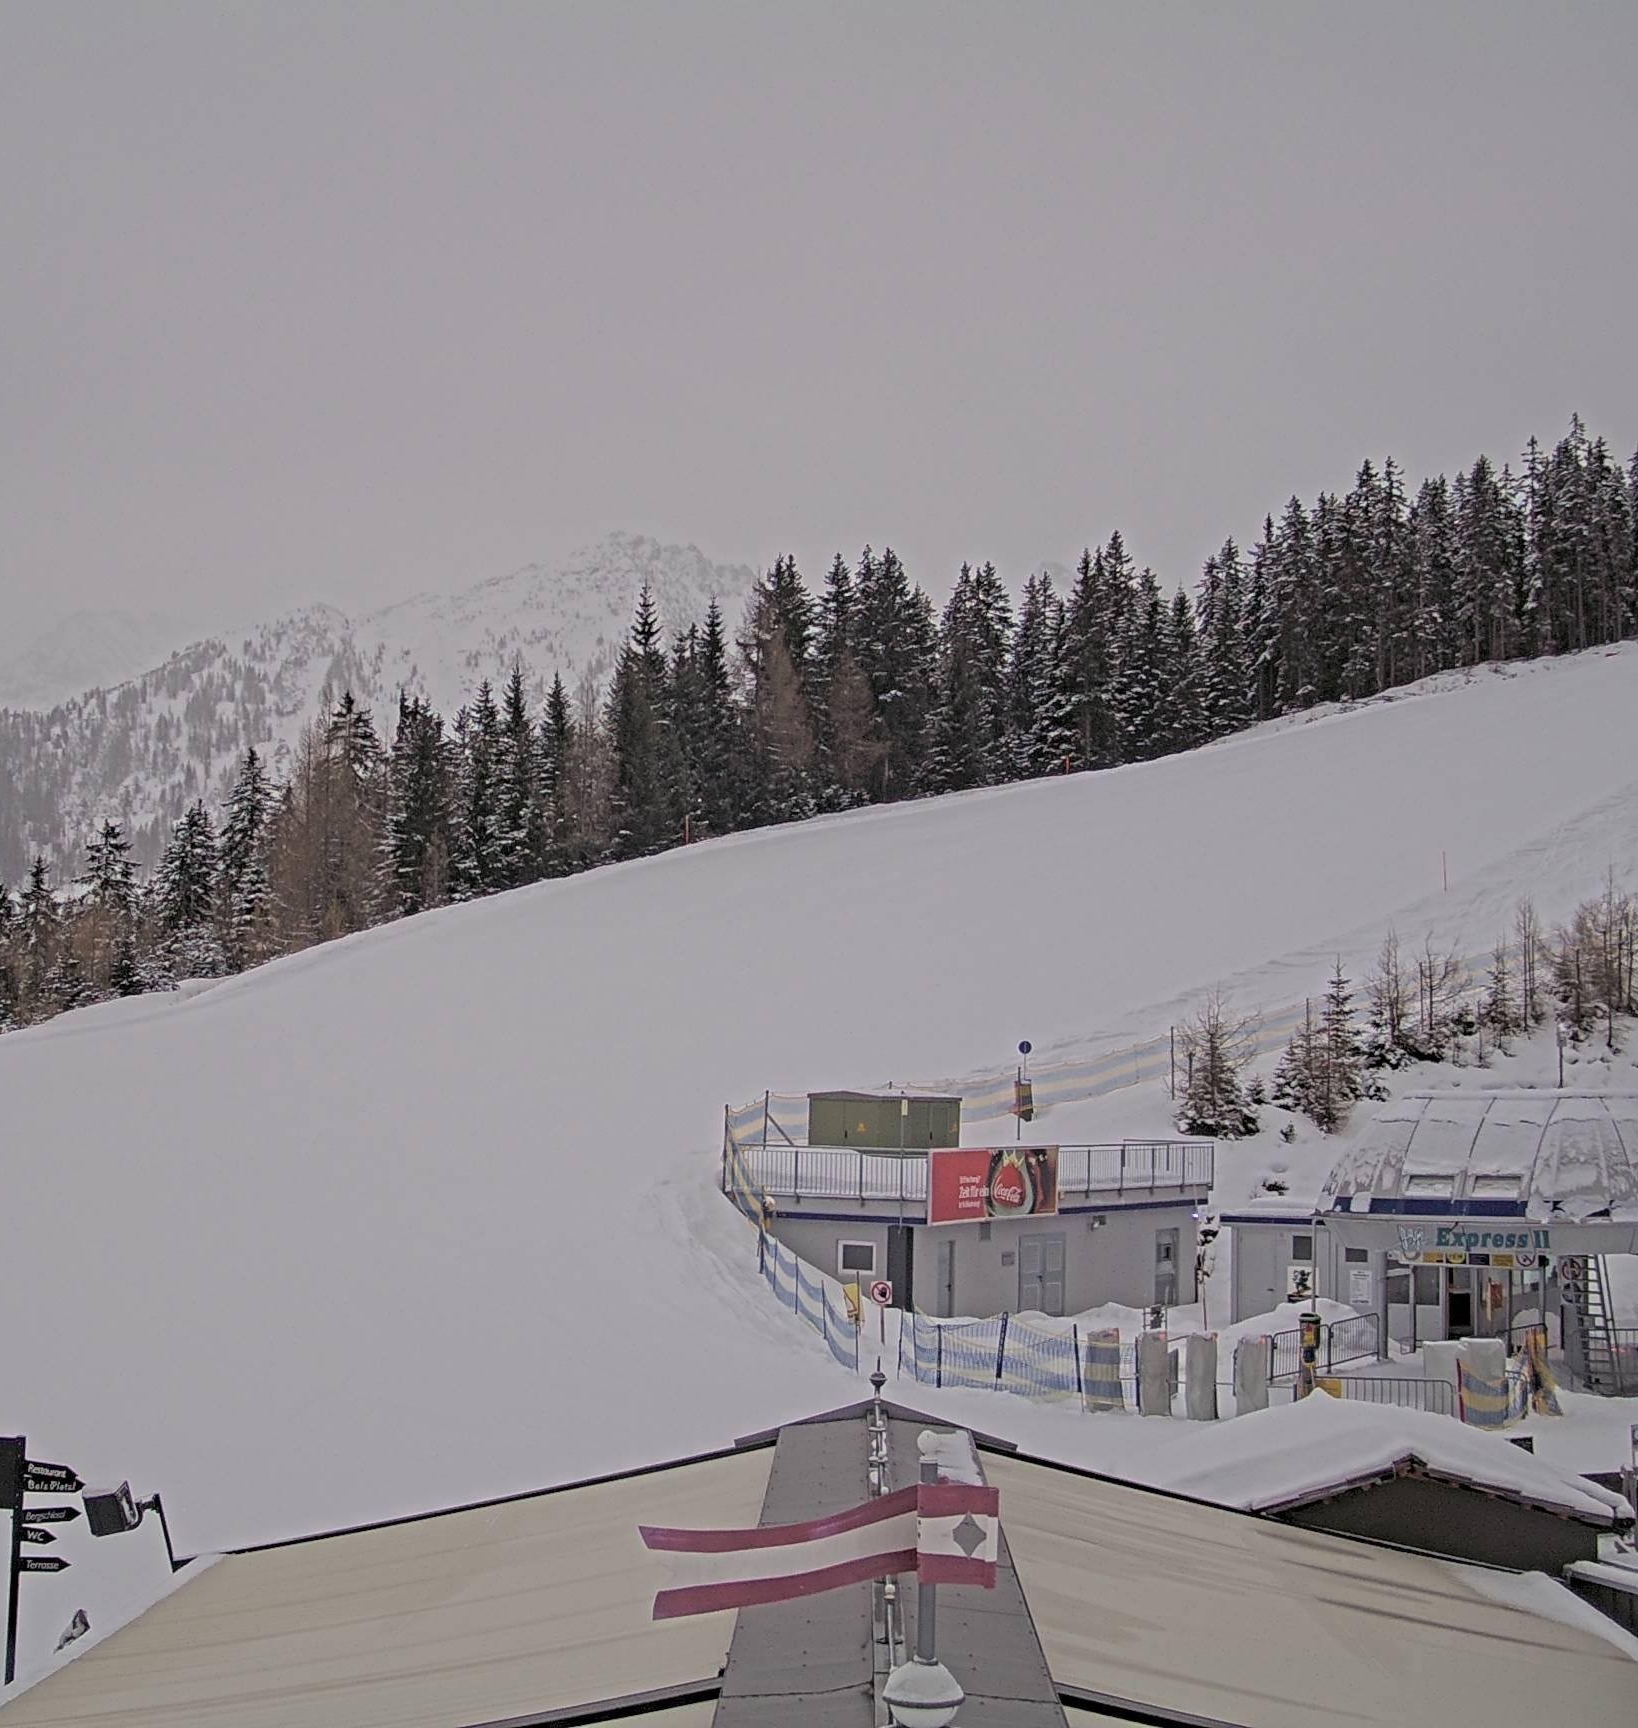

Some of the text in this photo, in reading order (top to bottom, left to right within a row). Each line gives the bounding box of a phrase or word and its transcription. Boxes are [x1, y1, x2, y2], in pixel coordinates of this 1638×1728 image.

[1436, 1227, 1528, 1251] Express
[28, 1463, 67, 1479] Restaurant
[27, 1530, 45, 1541] WC
[26, 1560, 59, 1570] Terrasse
